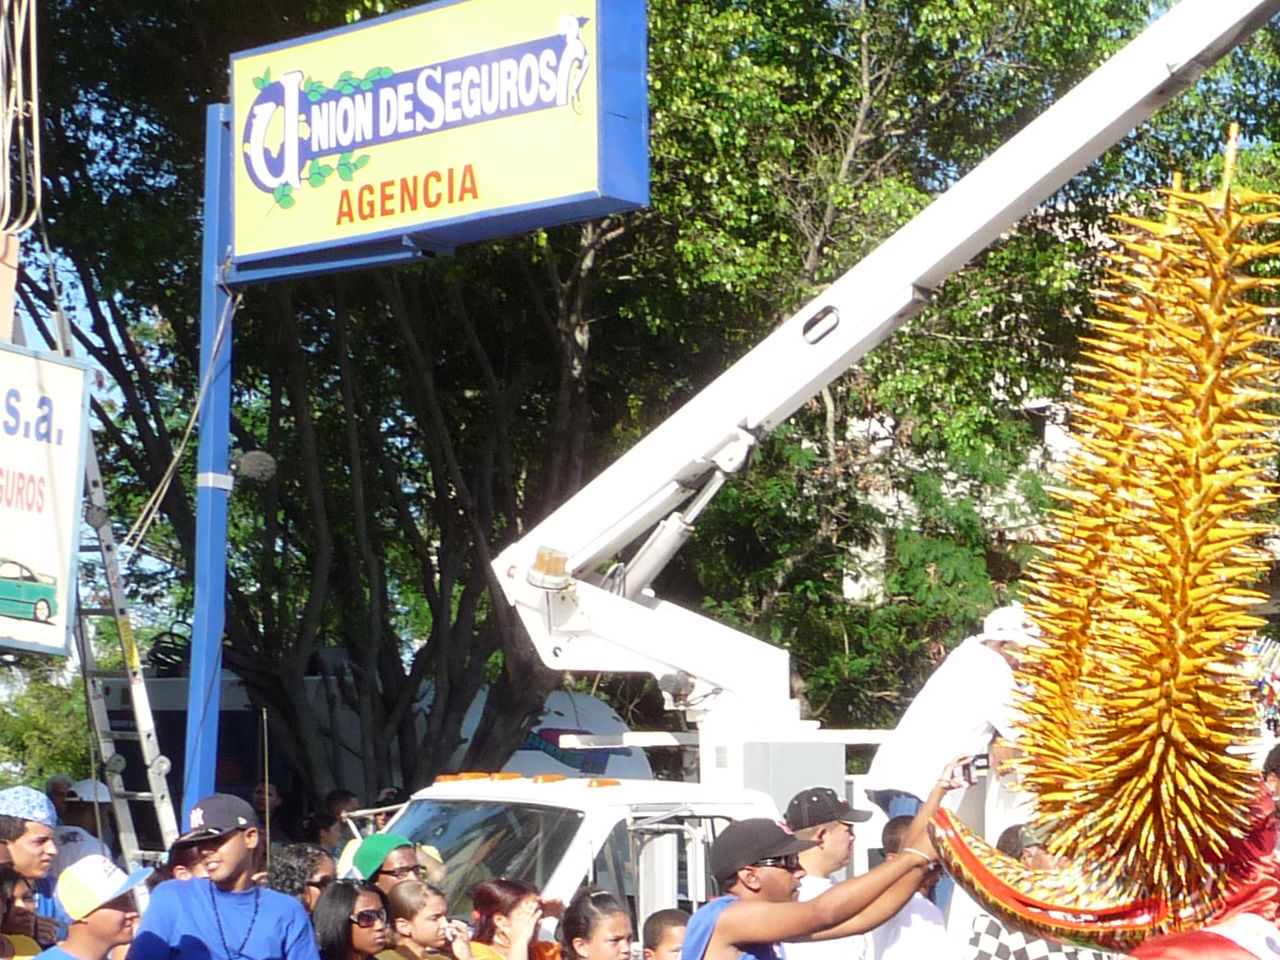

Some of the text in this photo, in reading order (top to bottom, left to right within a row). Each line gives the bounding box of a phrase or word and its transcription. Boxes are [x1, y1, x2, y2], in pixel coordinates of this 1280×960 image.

[250, 48, 557, 190] UNION DE SEGUROS
[336, 163, 479, 226] AGENCIA
